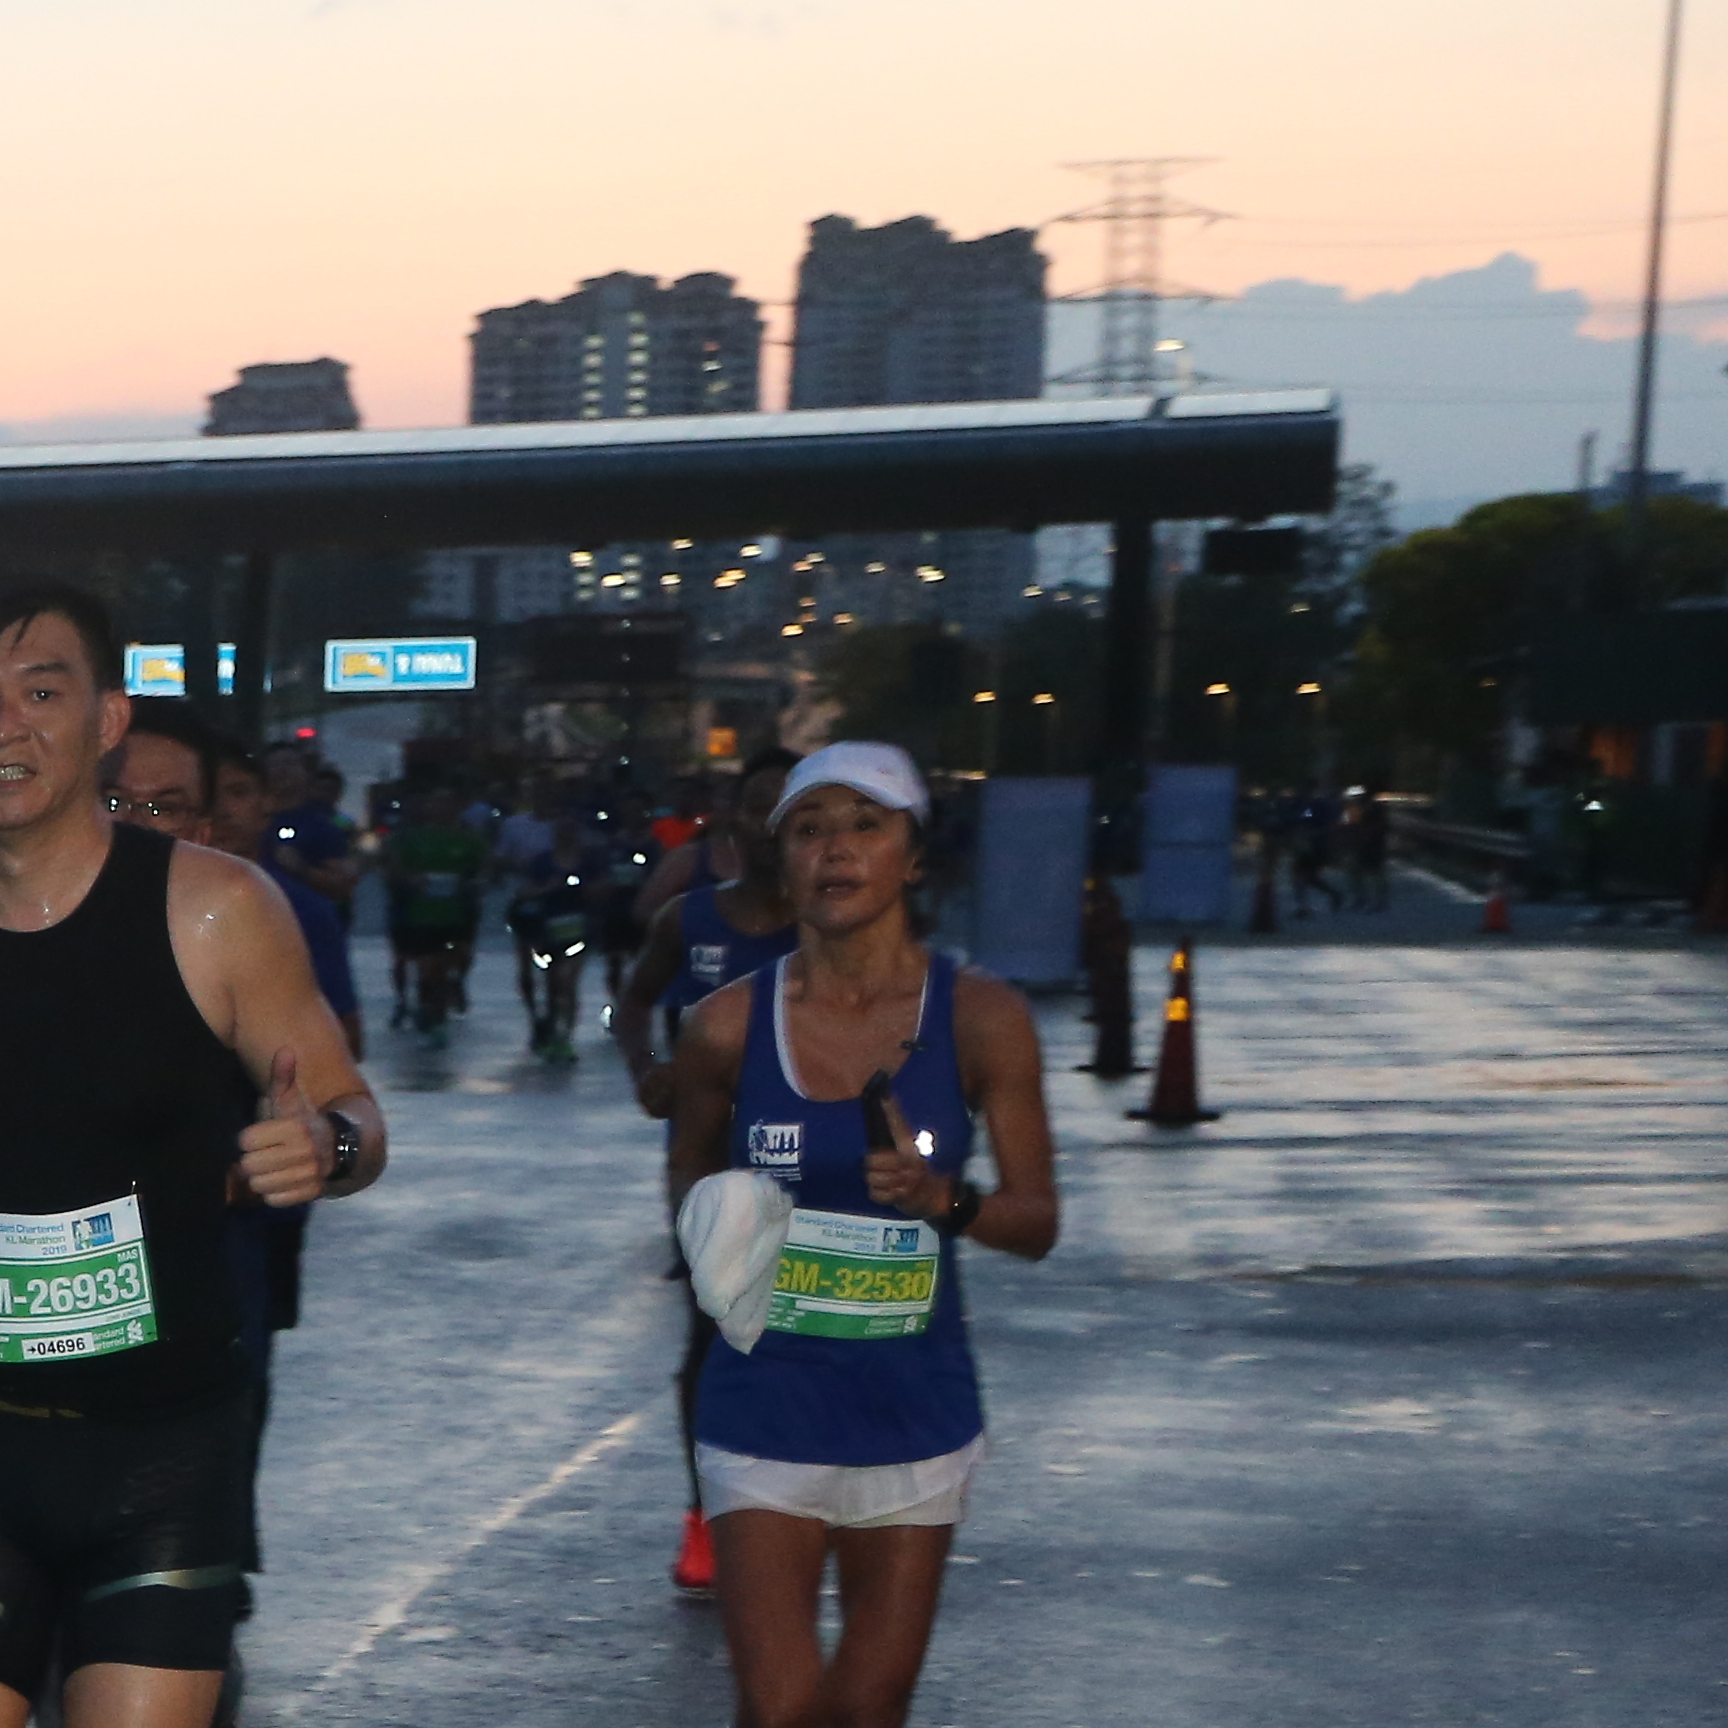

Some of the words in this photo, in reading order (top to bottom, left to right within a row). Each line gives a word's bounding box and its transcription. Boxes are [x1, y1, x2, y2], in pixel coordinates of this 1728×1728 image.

[5, 1236, 17, 1244] KL
[19, 1235, 66, 1245] Marathon
[117, 1249, 138, 1263] MAS
[774, 1258, 932, 1301] GM-32530
[93, 1326, 124, 1340] andard
[37, 1337, 86, 1356] 04696
